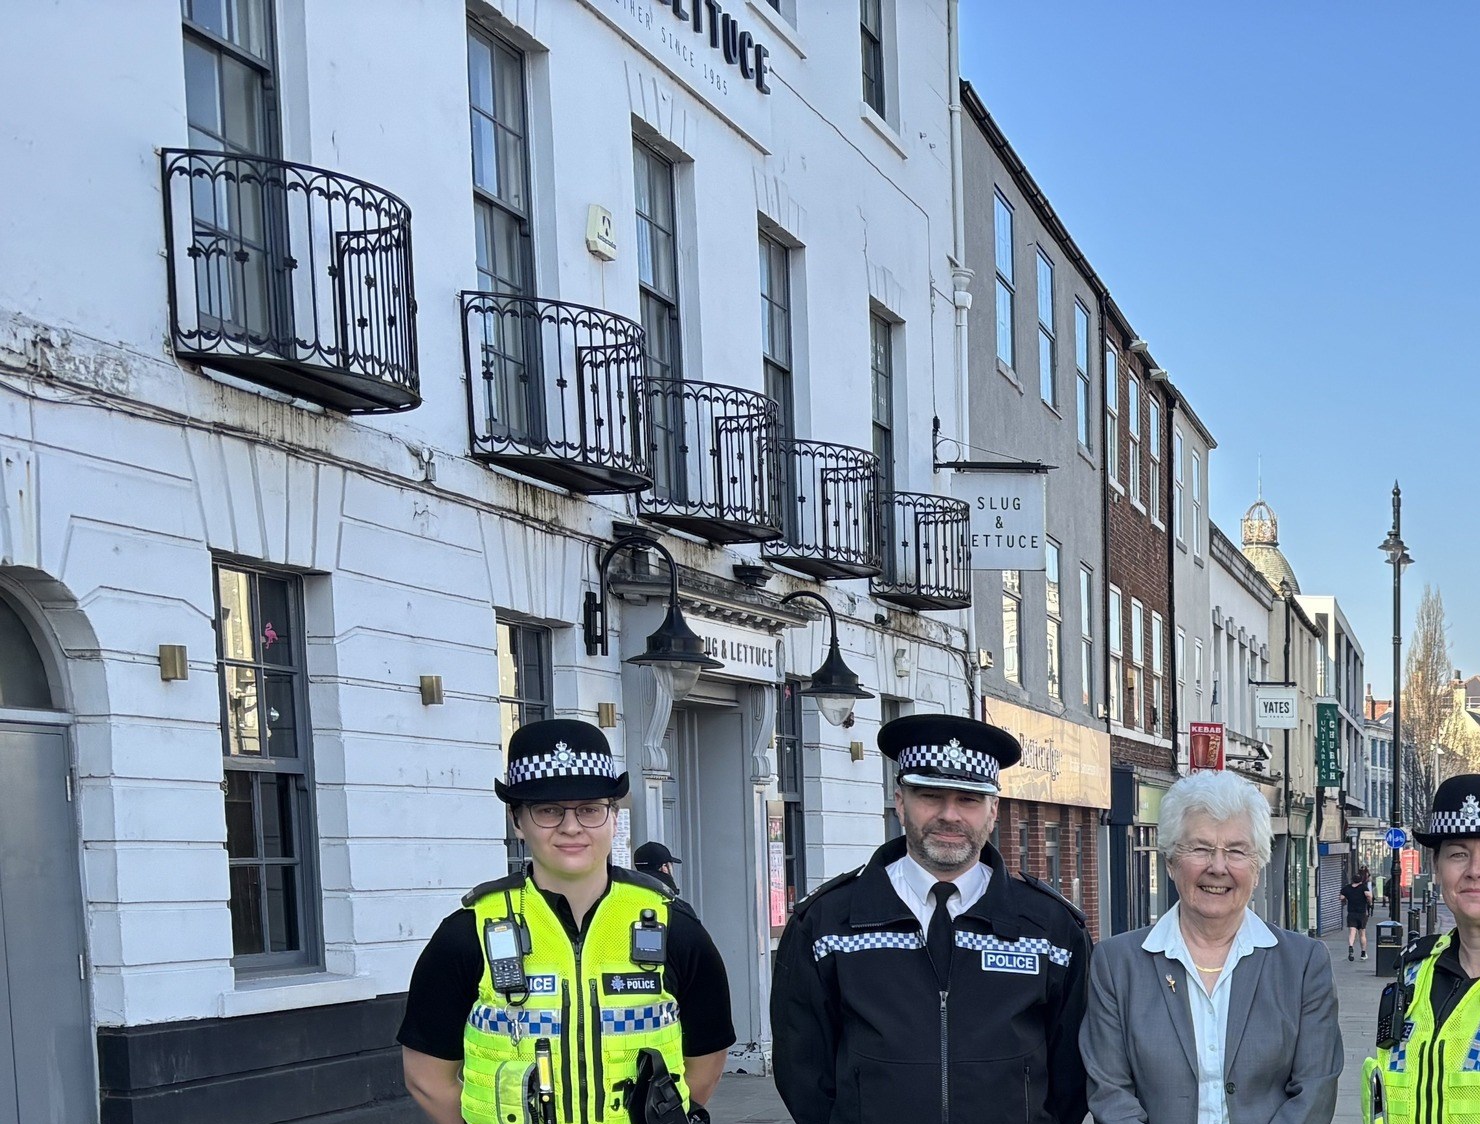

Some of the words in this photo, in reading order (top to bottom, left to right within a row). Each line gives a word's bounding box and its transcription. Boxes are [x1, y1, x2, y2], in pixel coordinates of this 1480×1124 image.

[660, 26, 695, 68] SINCE
[703, 63, 728, 96] 1985
[977, 496, 1021, 510] SLUG
[995, 516, 1004, 529] &
[720, 640, 728, 660] &
[730, 641, 774, 668] LETTUCE
[1263, 701, 1290, 714] YATES
[1191, 725, 1222, 734] KEBAB
[1328, 720, 1336, 780] CHURCH
[987, 954, 1034, 969] POLICE
[529, 977, 553, 991] ICE
[626, 980, 655, 990] POLICE
